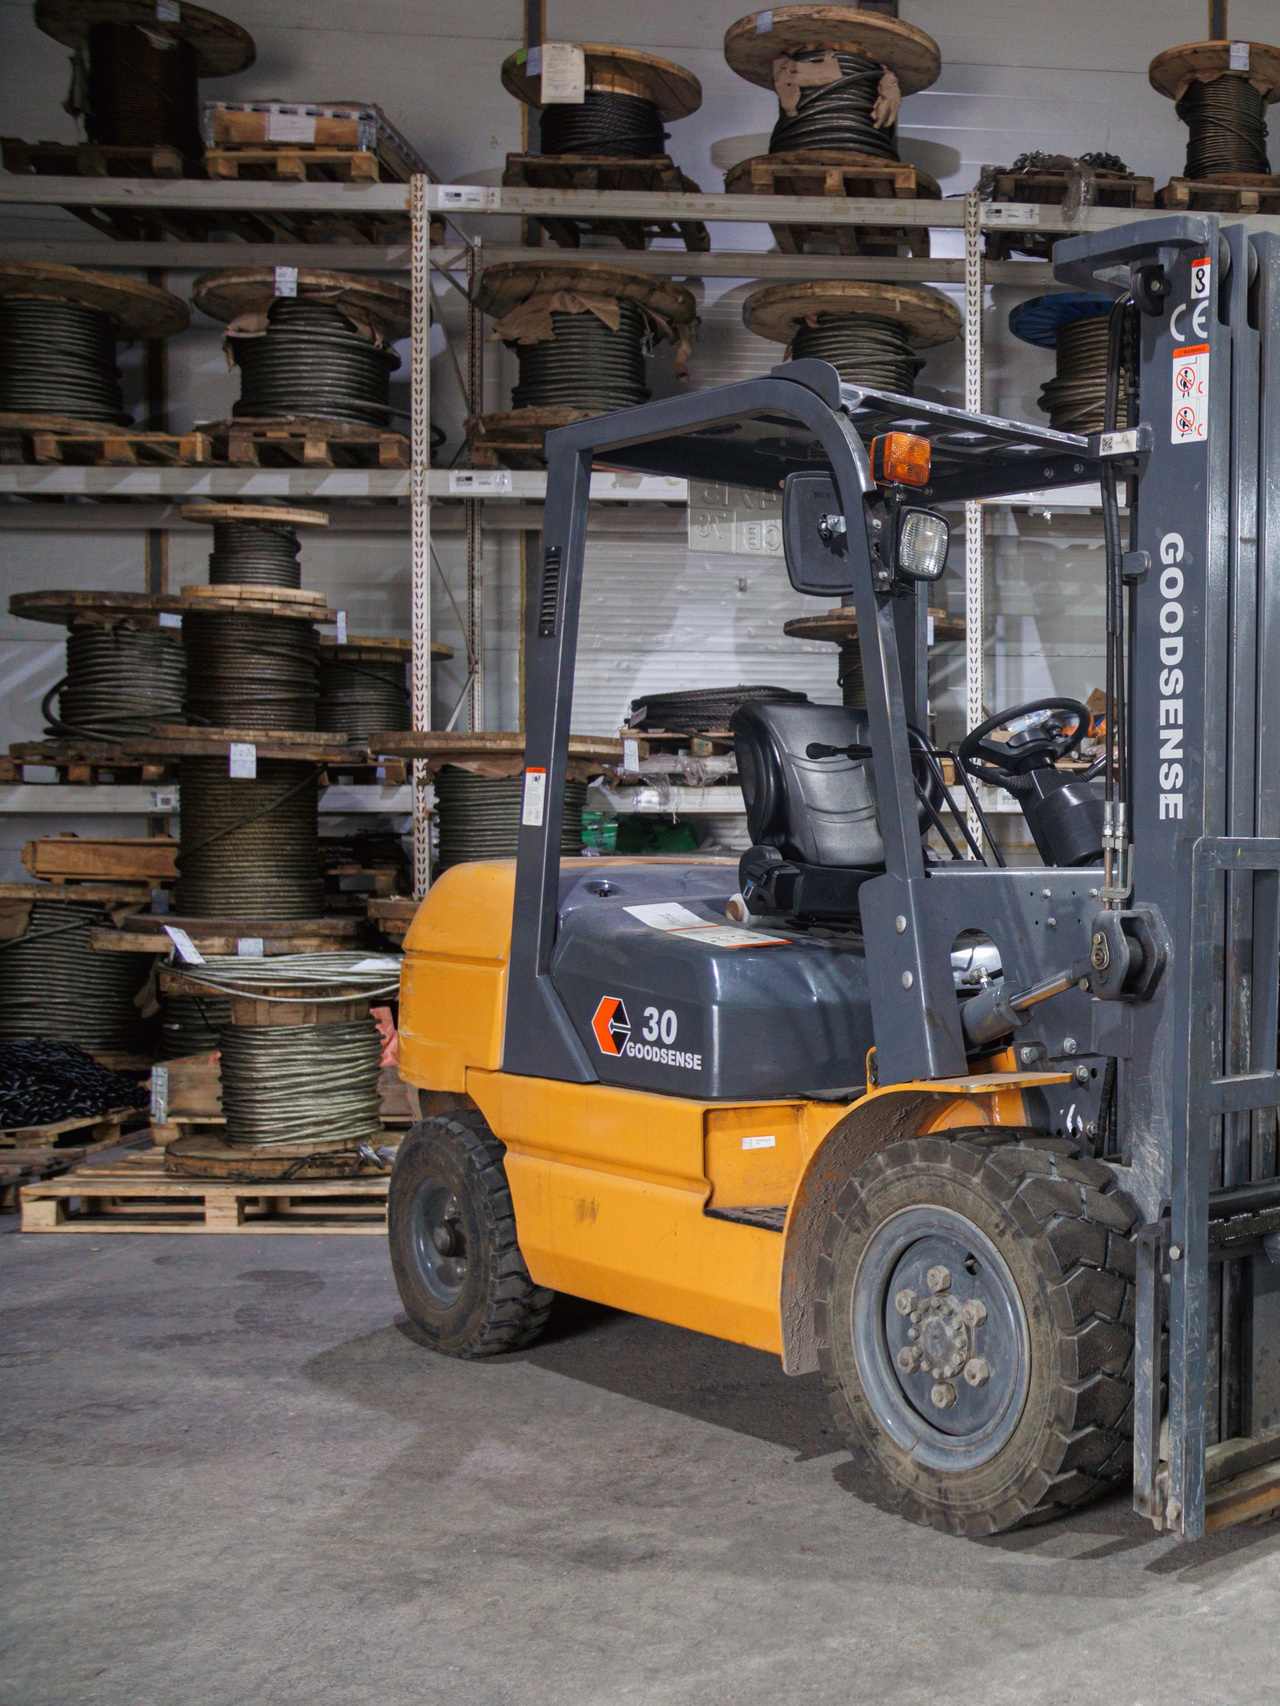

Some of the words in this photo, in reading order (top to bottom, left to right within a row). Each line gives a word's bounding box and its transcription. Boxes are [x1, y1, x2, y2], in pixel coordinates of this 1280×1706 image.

[1159, 532, 1184, 820] GOODSENSE
[642, 1006, 678, 1045] 30
[626, 1041, 702, 1071] GOODSENSE
